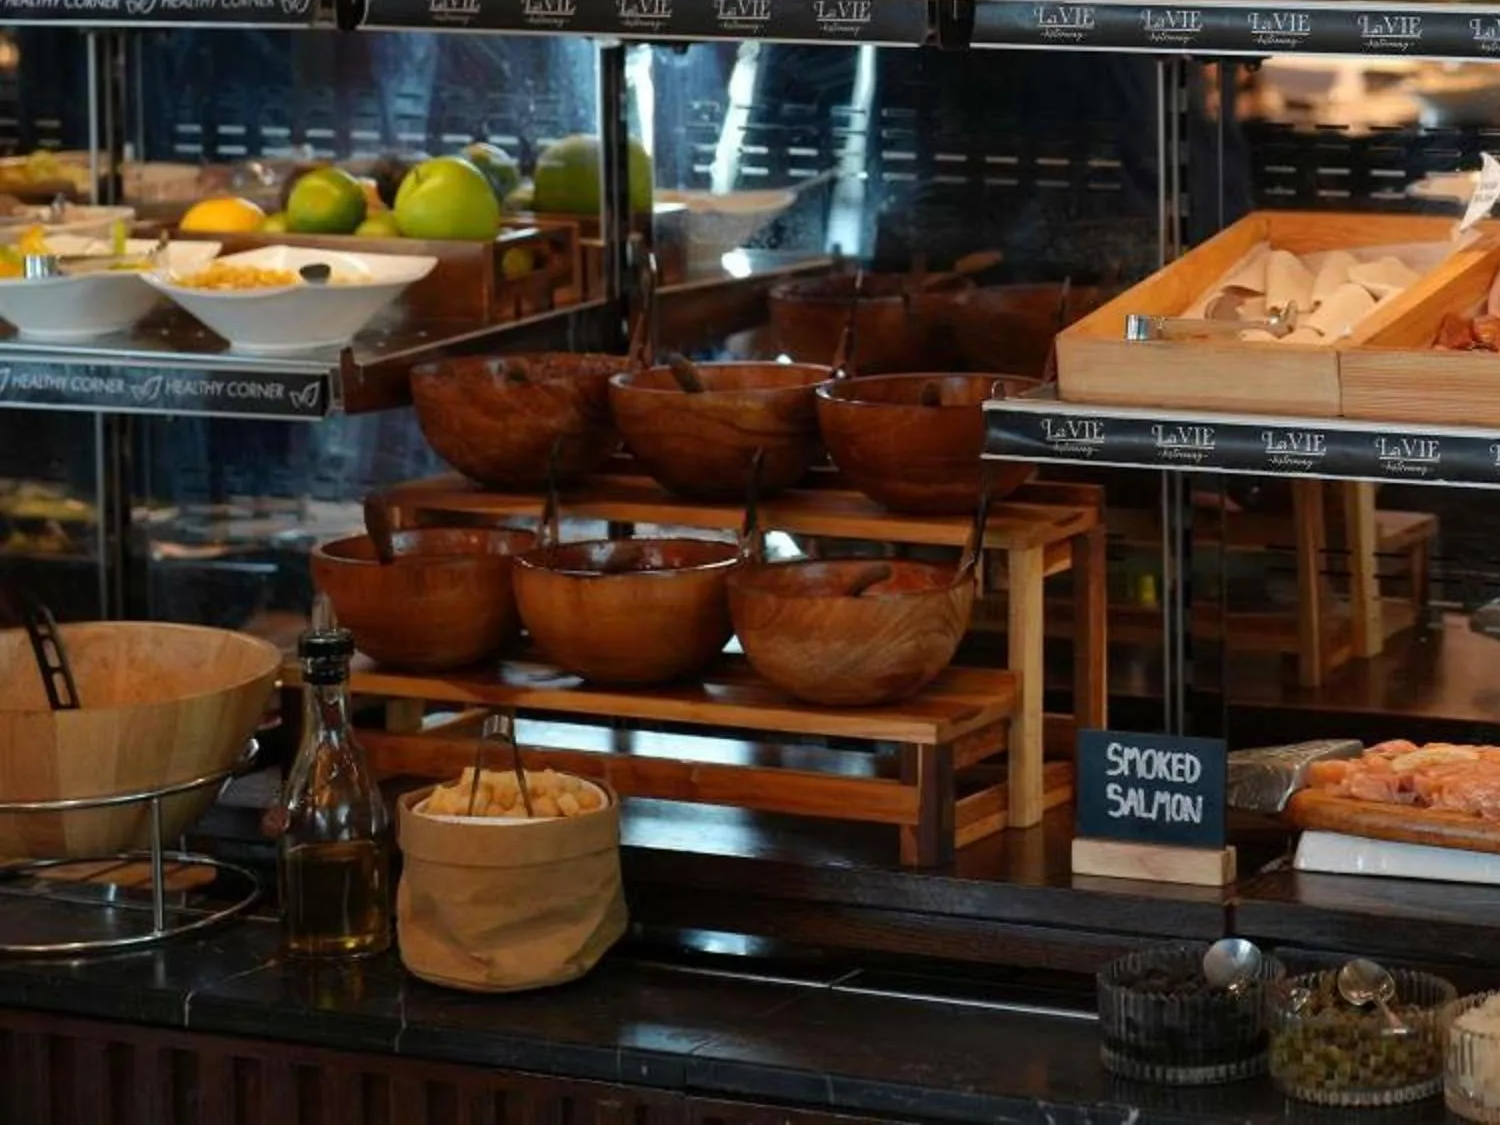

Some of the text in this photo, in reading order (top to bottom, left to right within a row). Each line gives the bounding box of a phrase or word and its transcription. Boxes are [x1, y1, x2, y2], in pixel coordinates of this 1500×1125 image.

[11, 374, 283, 399] HEALTHY CORNER HEALTHY CORNER
[1106, 743, 1202, 784] SMOKED
[1106, 783, 1203, 824] SALMON
